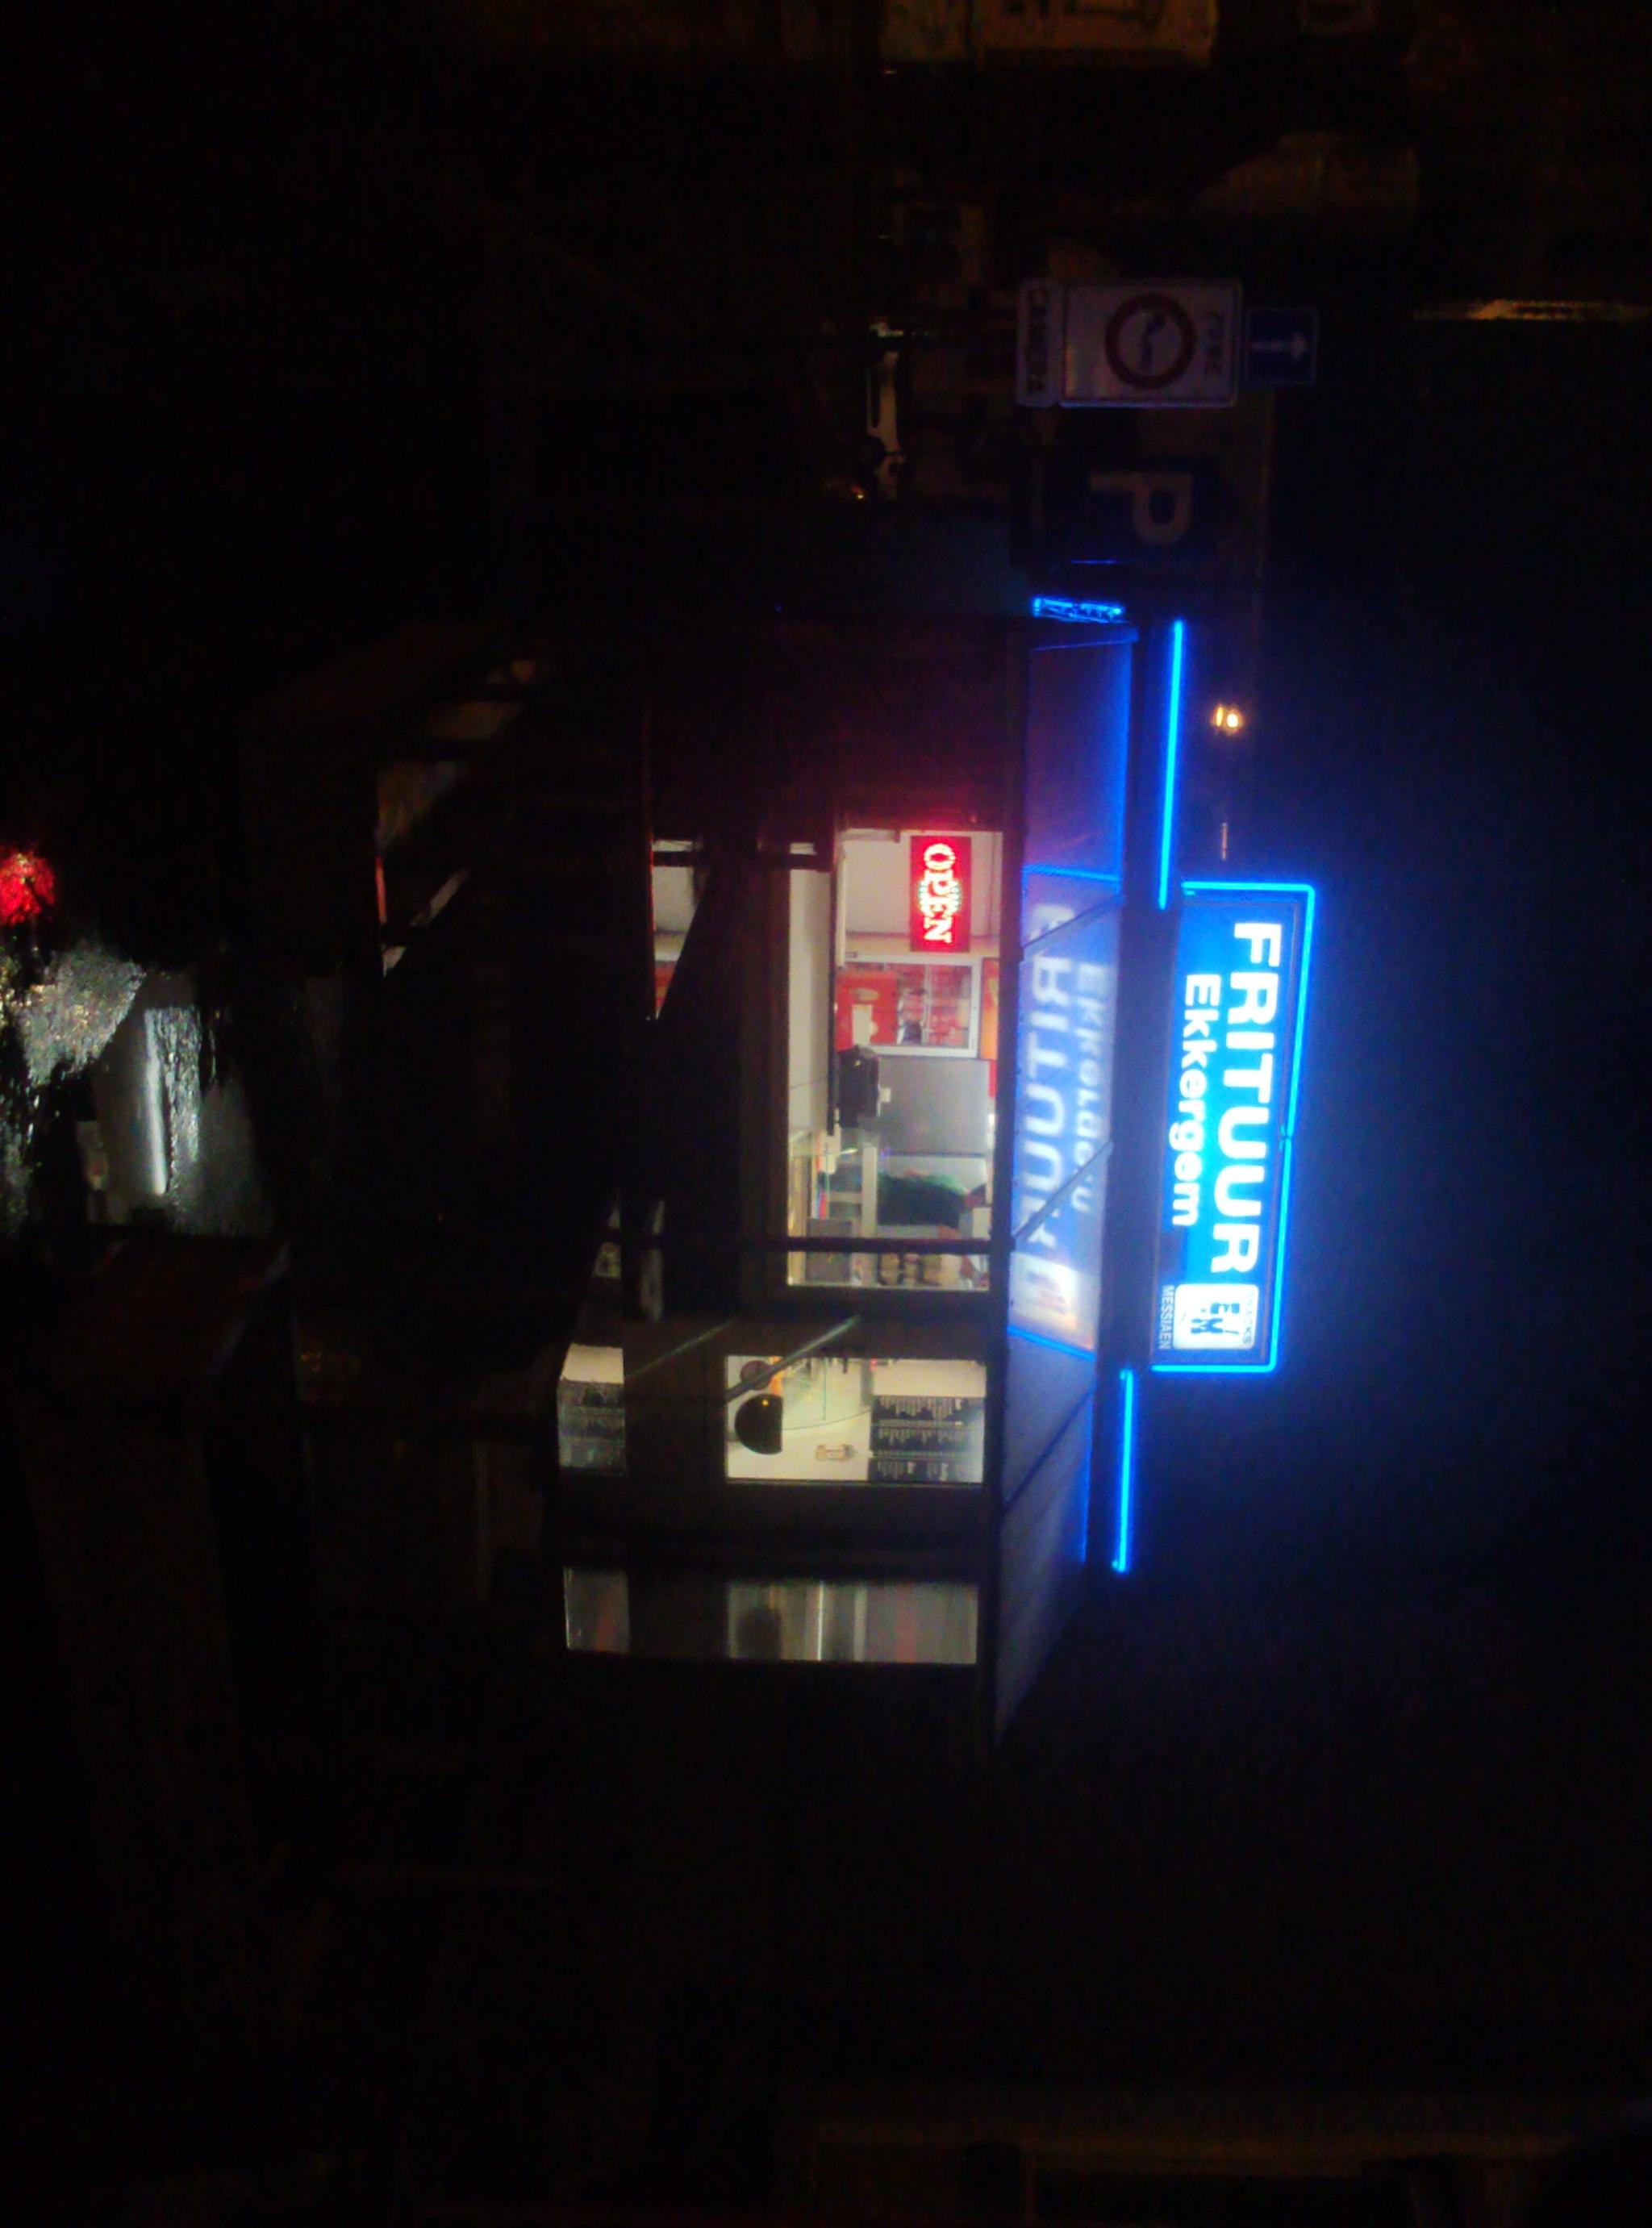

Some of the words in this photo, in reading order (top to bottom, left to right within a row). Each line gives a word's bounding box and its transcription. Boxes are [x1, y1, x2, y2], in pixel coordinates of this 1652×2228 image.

[1089, 470, 1193, 546] P
[923, 843, 958, 944] OPEN
[1168, 972, 1223, 1227] Ekkergem
[1209, 921, 1283, 1275] FRITUUR
[1158, 1284, 1174, 1350] MESSIAEN
